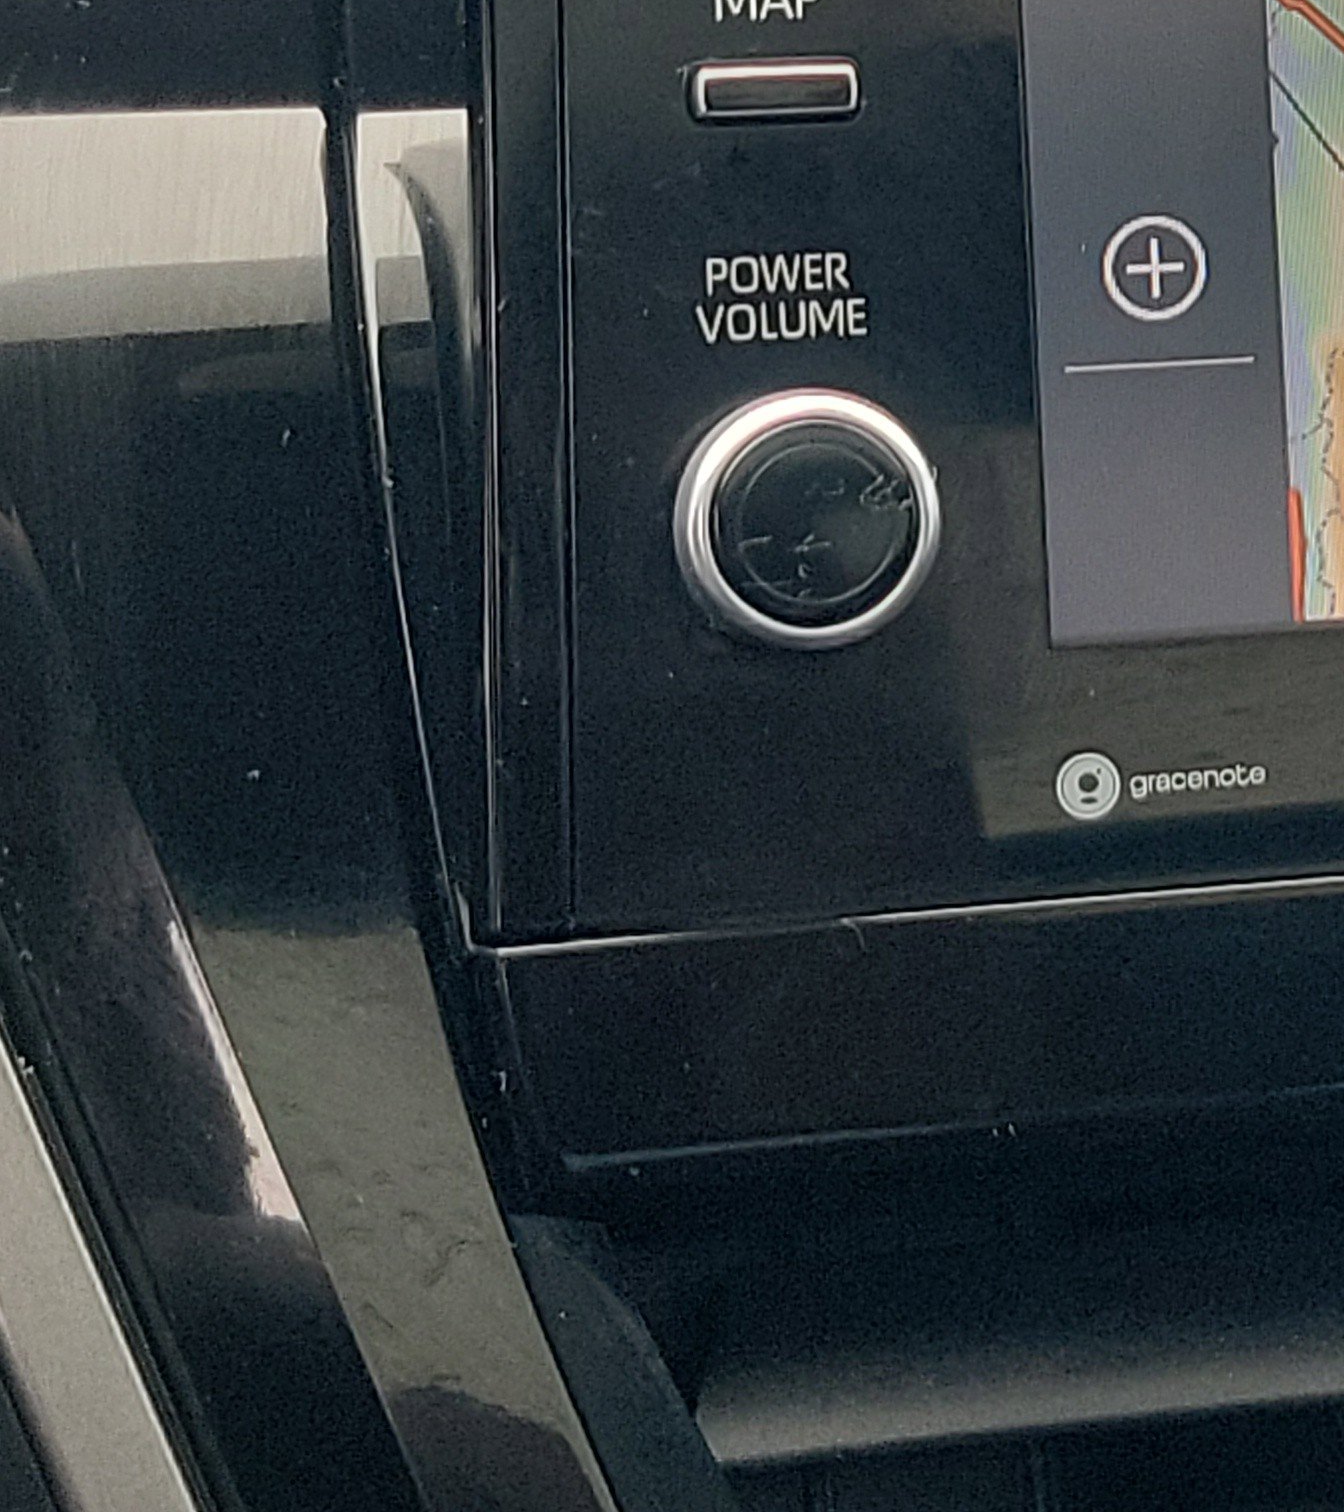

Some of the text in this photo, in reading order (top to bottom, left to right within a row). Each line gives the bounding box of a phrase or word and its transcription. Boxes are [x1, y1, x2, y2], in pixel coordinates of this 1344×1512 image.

[704, 251, 851, 296] POWER
[695, 297, 869, 344] VOLUME
[1129, 763, 1267, 801] gracenote
